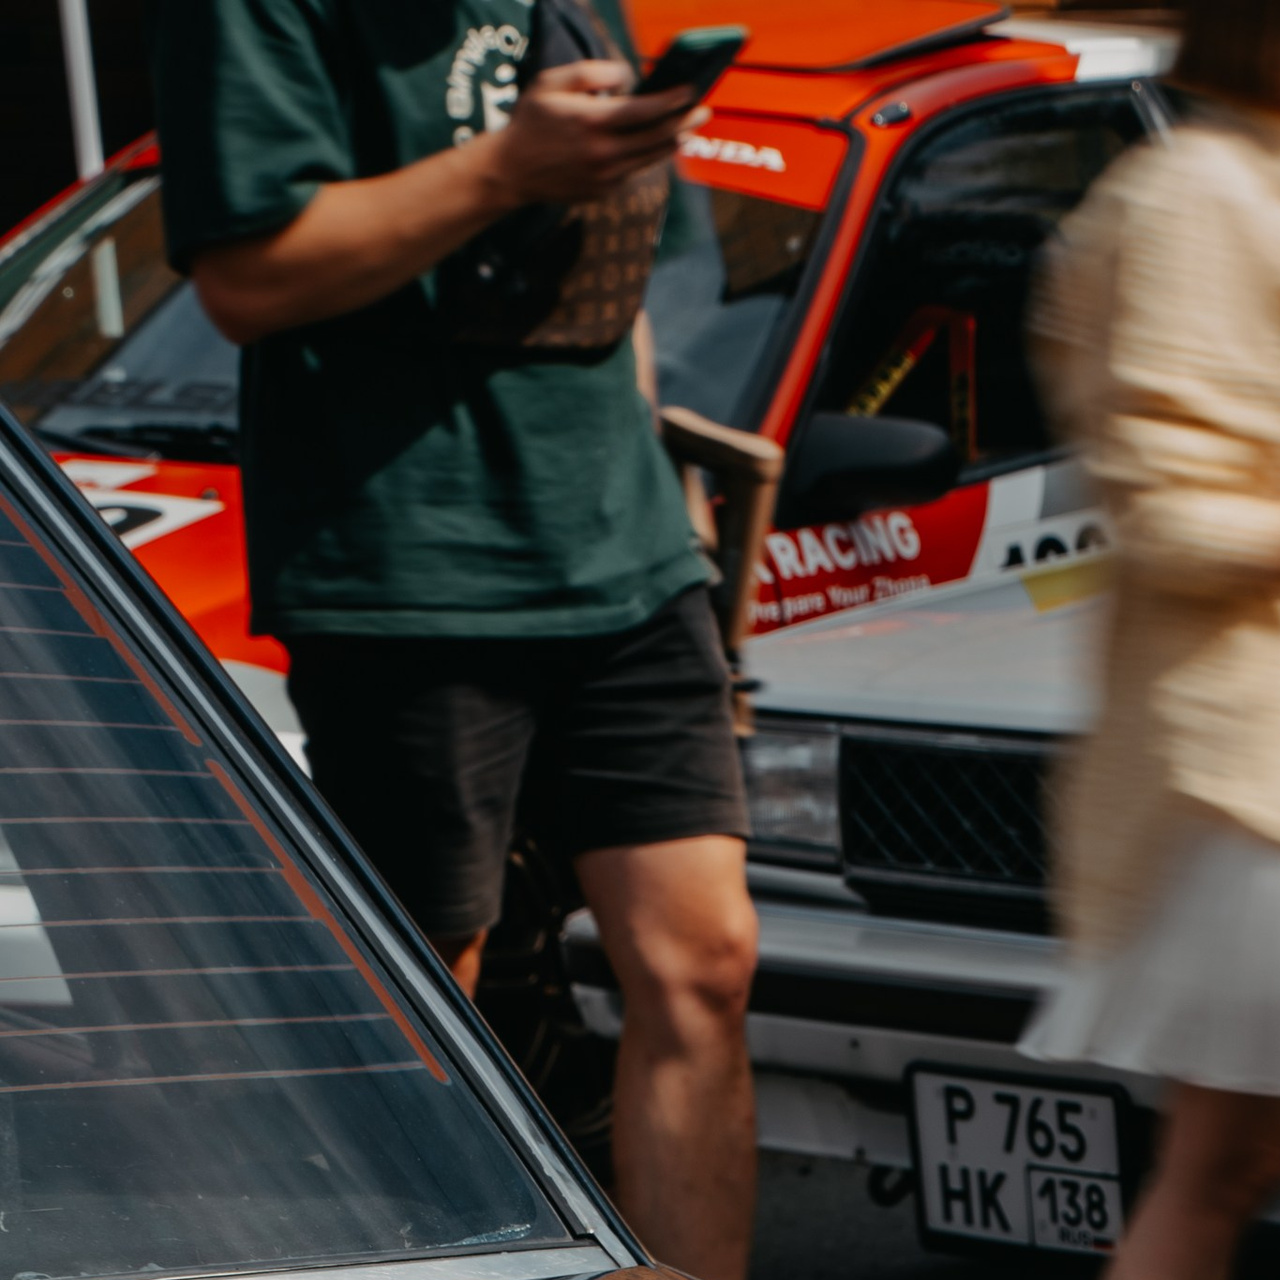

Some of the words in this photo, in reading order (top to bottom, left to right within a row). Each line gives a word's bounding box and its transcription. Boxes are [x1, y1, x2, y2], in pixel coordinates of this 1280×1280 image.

[677, 132, 787, 173] NDA
[764, 511, 921, 580] RACING
[993, 1091, 1087, 1163] 765
[1037, 1177, 1109, 1231] 138
